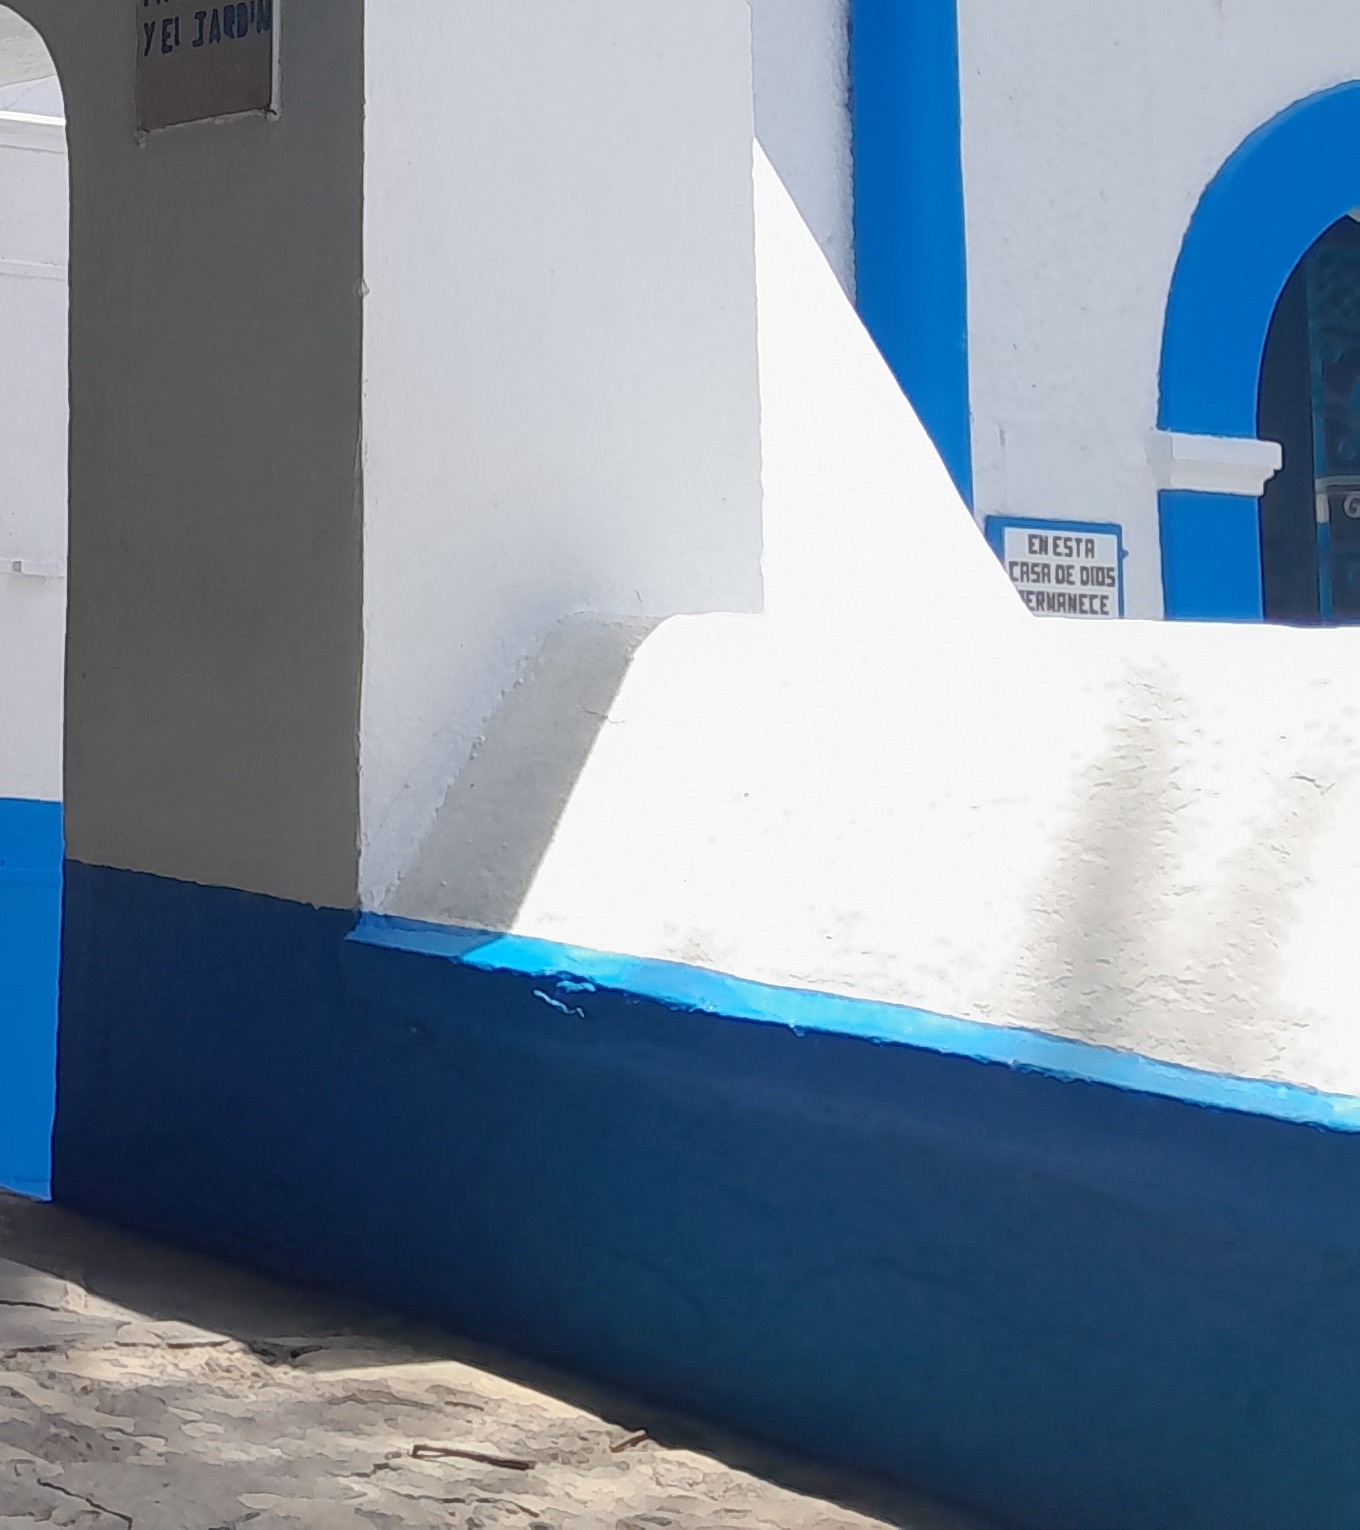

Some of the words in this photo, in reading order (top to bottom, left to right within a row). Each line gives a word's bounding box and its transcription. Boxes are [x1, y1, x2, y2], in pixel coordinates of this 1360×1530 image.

[143, 20, 156, 58] Y
[1027, 533, 1049, 556] EN
[1052, 536, 1095, 559] ESTA
[1008, 561, 1051, 584] CASA
[1055, 563, 1076, 586] DE
[1079, 565, 1116, 588] DIOS
